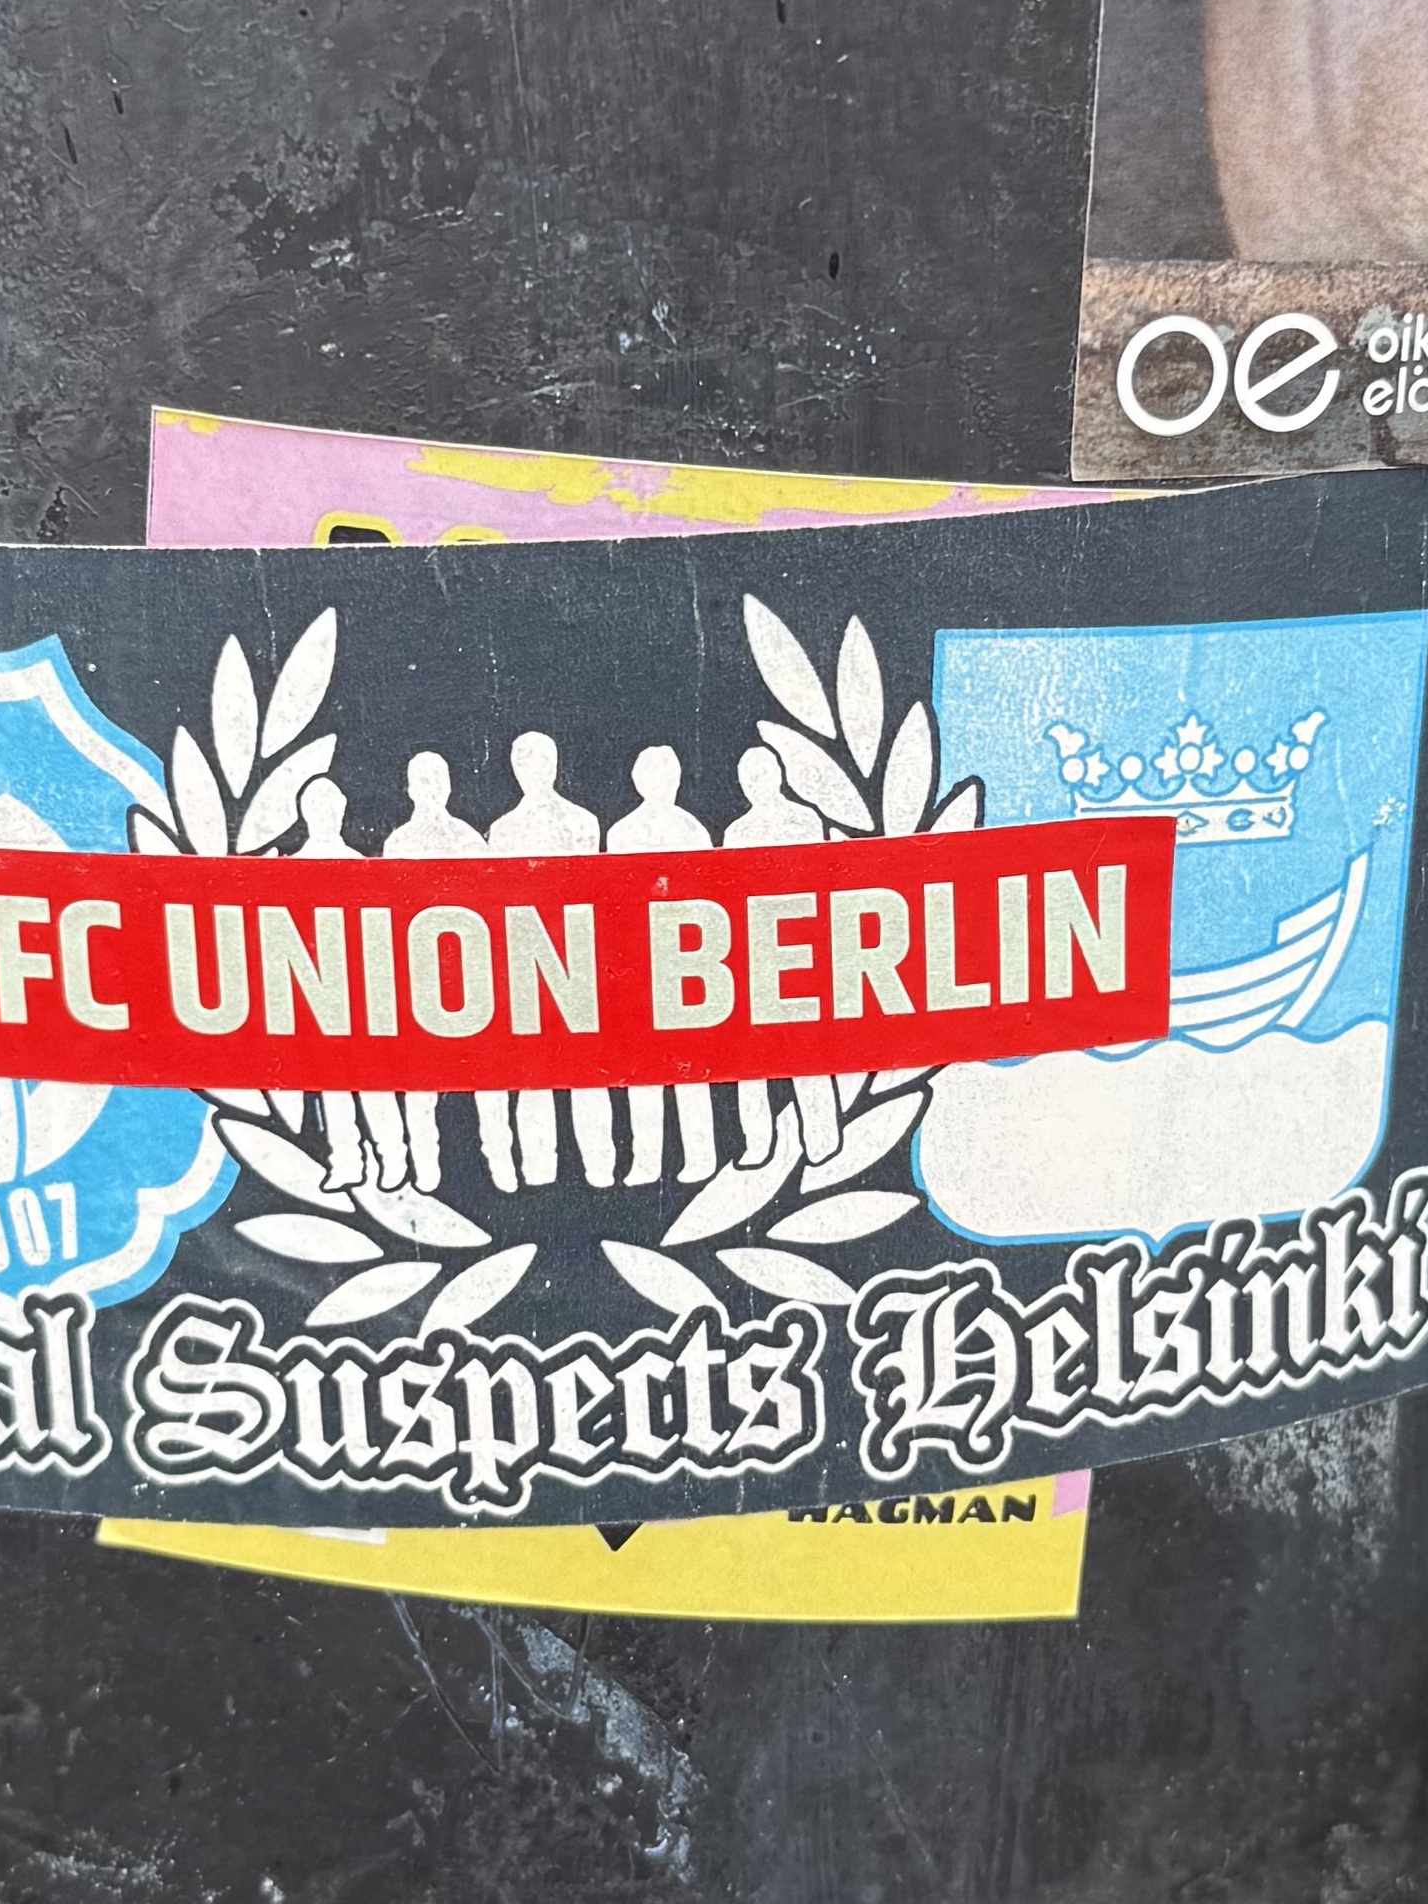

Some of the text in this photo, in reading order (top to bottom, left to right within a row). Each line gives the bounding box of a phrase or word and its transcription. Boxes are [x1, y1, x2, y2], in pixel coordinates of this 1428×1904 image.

[164, 902, 600, 1038] UNION
[647, 863, 1128, 1032] BERLIN
[134, 1304, 814, 1504] Suspects
